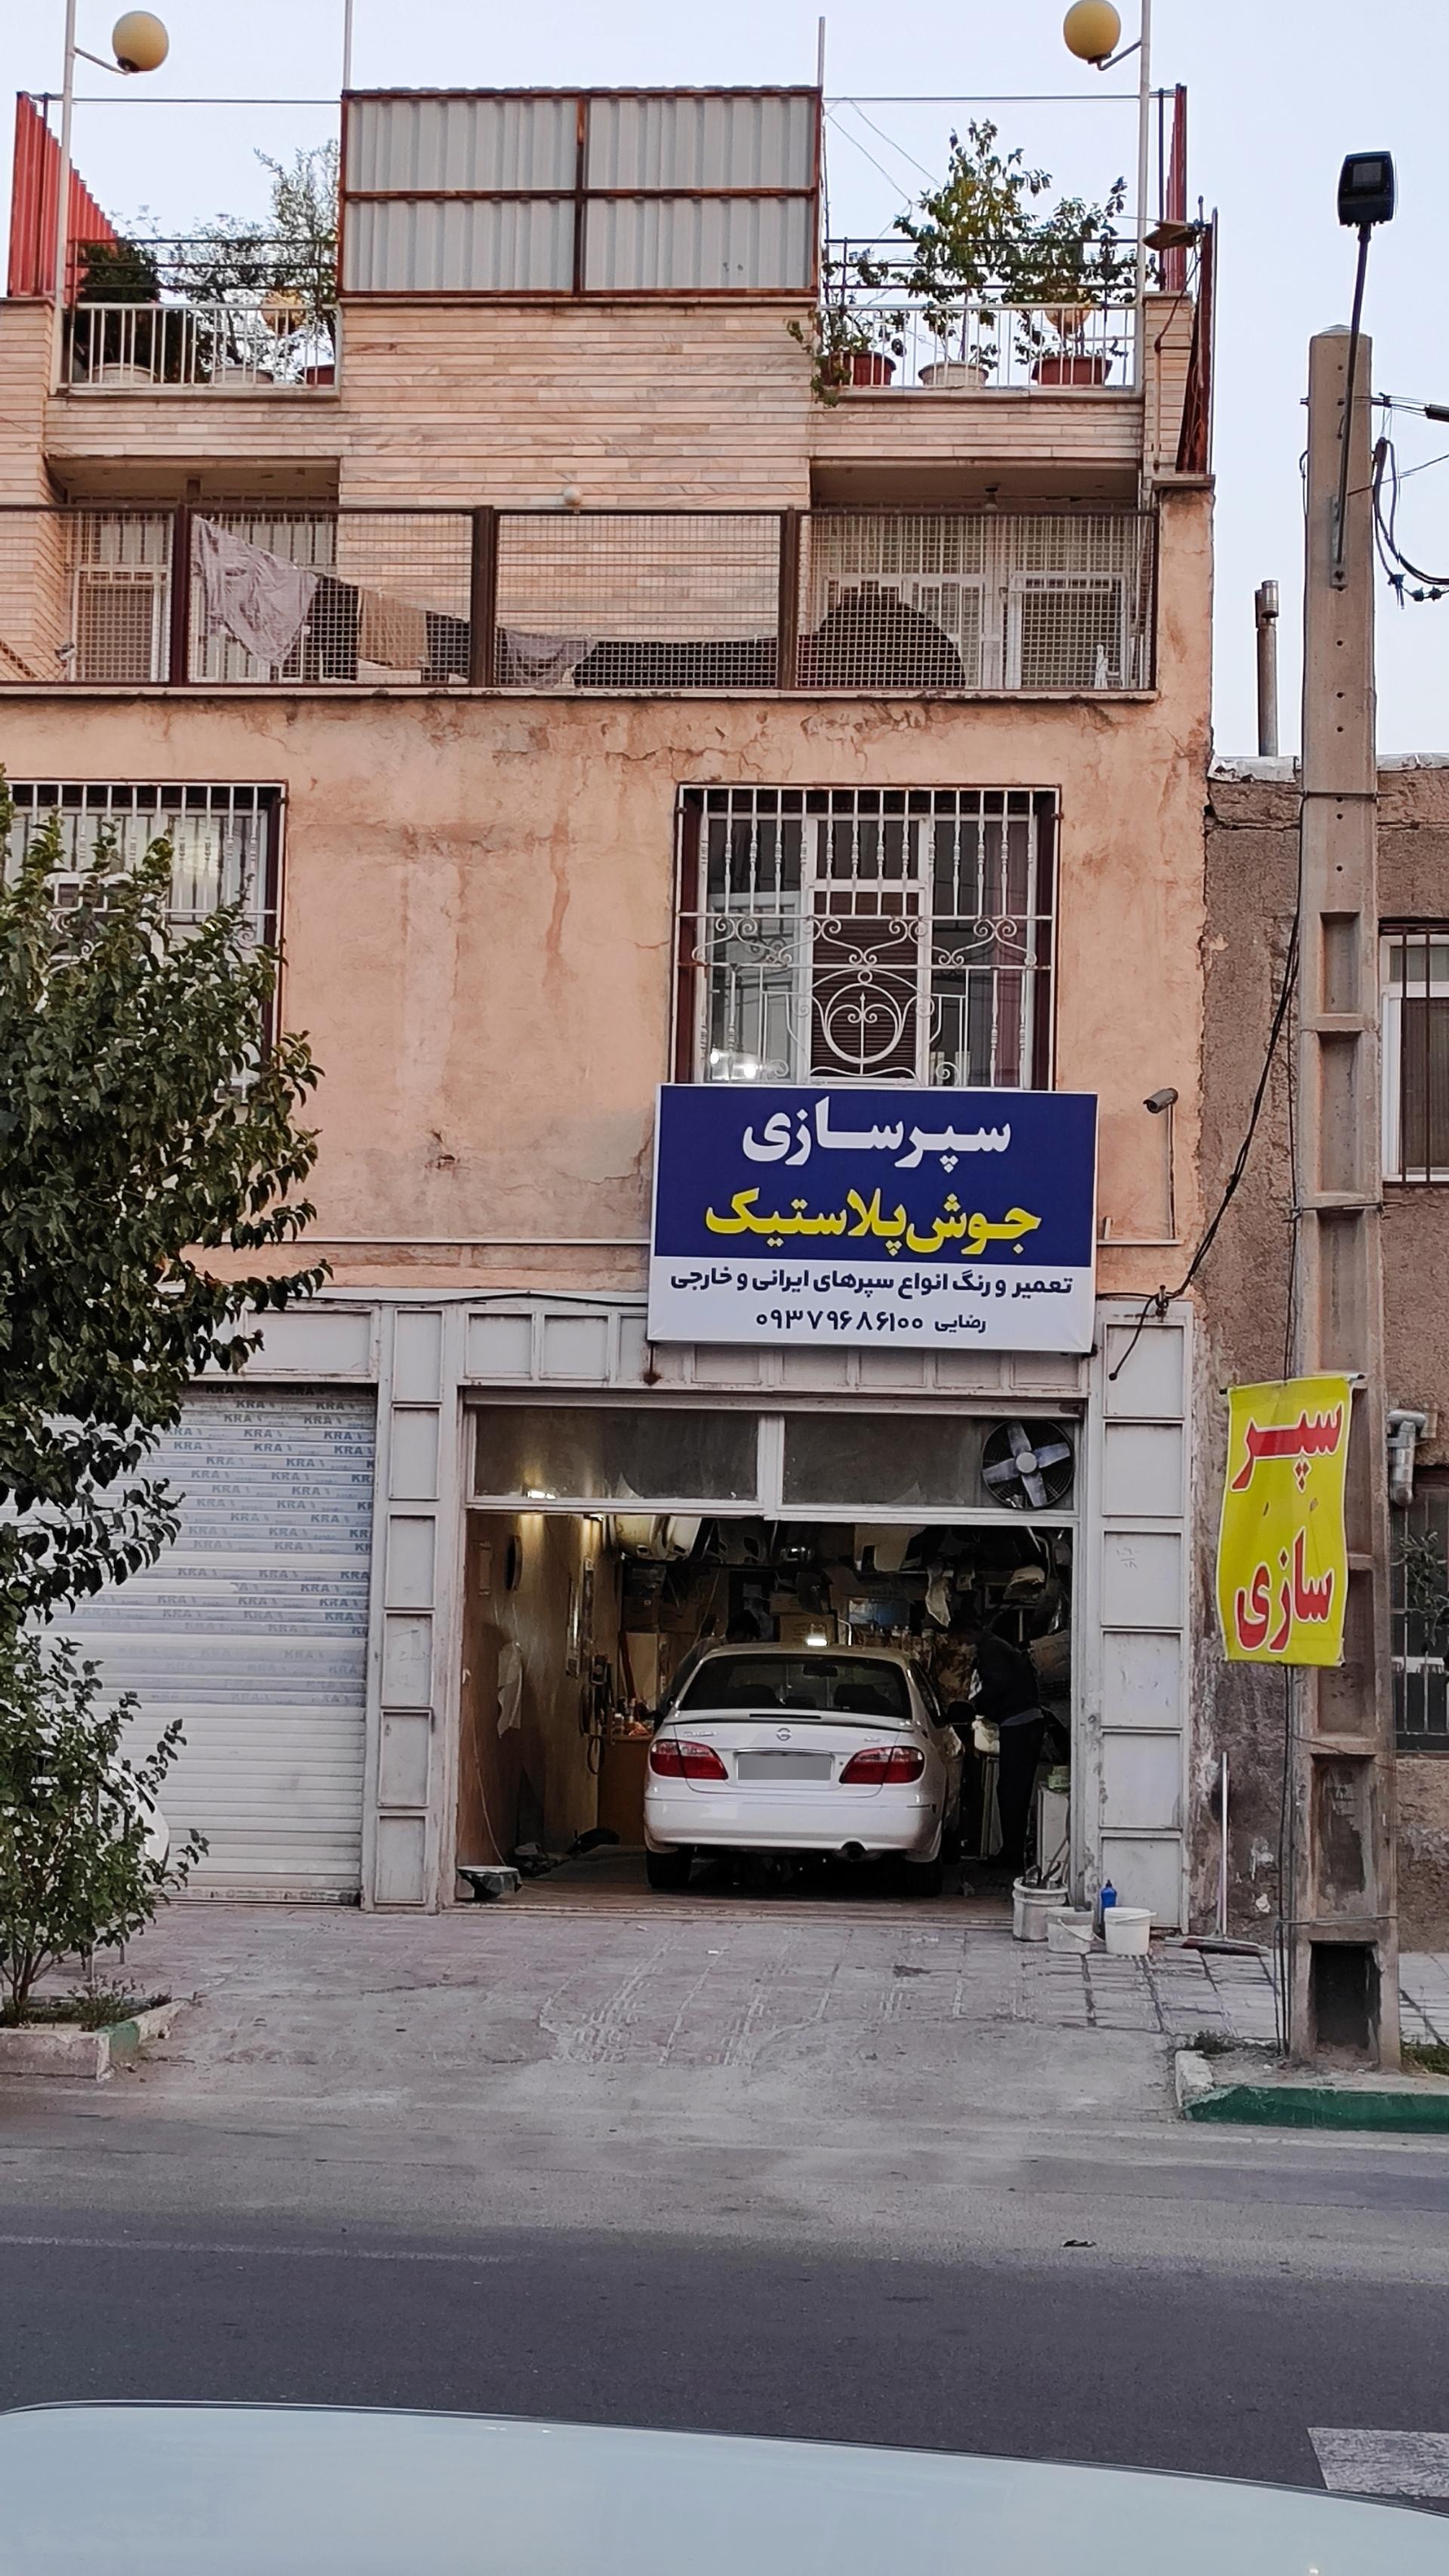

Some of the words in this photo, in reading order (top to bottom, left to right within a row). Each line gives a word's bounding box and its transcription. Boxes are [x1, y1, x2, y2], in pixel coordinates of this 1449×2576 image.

[705, 1188, 907, 1256] پلاستیک
[906, 1193, 1042, 1254] جوش
[670, 1266, 734, 1291] خارجی
[737, 1273, 749, 1291] و
[752, 1269, 810, 1294] ایرانی
[813, 1270, 895, 1298] سپرهای
[897, 1273, 949, 1300] انواع
[952, 1270, 992, 1297] رنگ
[1011, 1277, 1073, 1299] تعمیر
[995, 1279, 1008, 1298] و
[934, 1314, 986, 1334] رضایی
[235, 1400, 265, 1409] KRA
[315, 1402, 345, 1411] KRA
[223, 1414, 253, 1423] KRA
[303, 1416, 332, 1425] KRA
[243, 1429, 272, 1438] KRA
[324, 1431, 352, 1440] KRA
[174, 1442, 203, 1450] KRA
[254, 1443, 282, 1452] KRA
[334, 1445, 363, 1454] KRA
[1231, 1402, 1343, 1493] سپر
[286, 1458, 315, 1467] KRA
[191, 1470, 220, 1479] KRA
[271, 1472, 300, 1480] KRA
[291, 1486, 321, 1495] KRA
[276, 1500, 306, 1509] KRA
[311, 1514, 340, 1523] KRA
[1235, 1527, 1335, 1653] سازی
